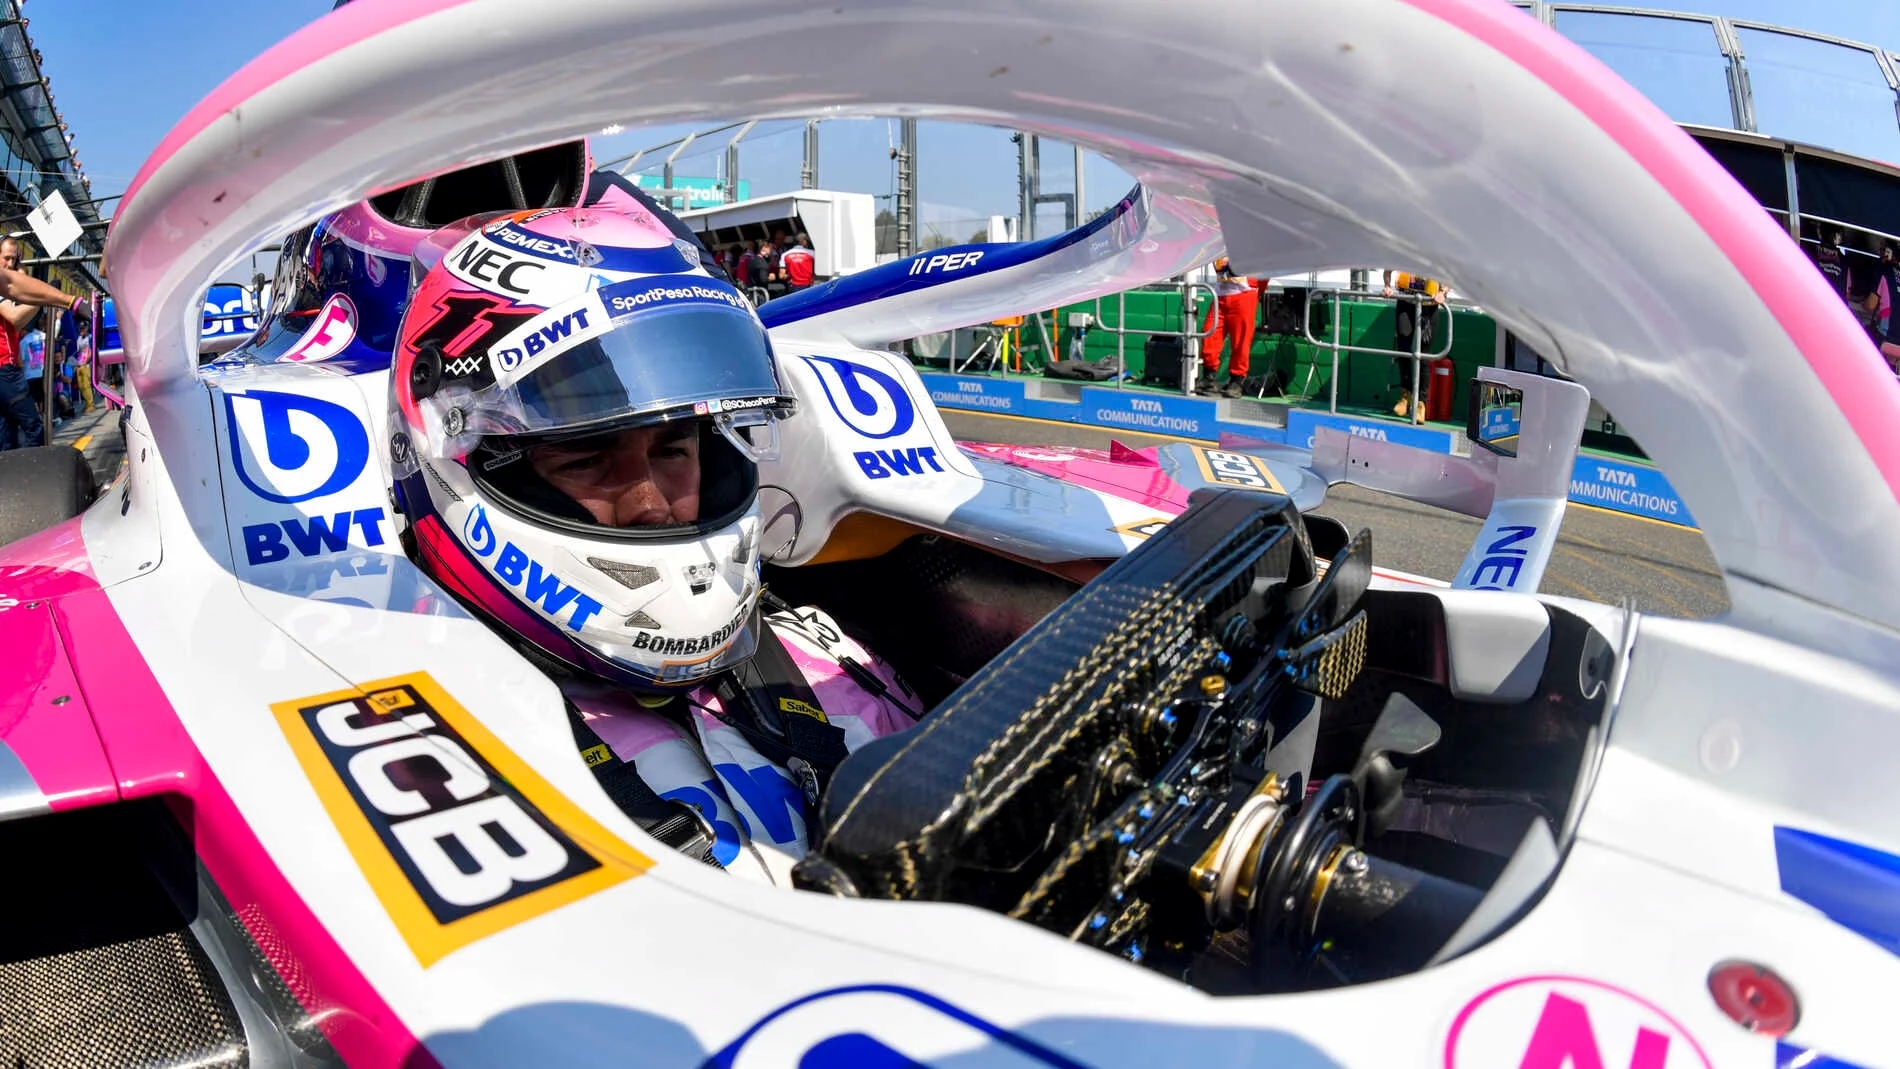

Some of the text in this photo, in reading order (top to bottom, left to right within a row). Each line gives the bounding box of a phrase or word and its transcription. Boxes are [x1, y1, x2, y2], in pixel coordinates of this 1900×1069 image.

[450, 240, 546, 295] NEC
[925, 251, 985, 274] PER
[612, 287, 691, 311] SportPesa
[690, 285, 737, 305] Racing
[523, 308, 590, 357] BWT
[932, 390, 1012, 409] COMMUNICATIONS
[957, 381, 983, 394] TATA
[722, 396, 776, 411] @SChecoPerez
[1130, 398, 1163, 413] TATA
[1097, 408, 1199, 433] COMMUNICATIONS
[1349, 425, 1388, 442] TATA
[853, 446, 946, 480] BWT
[1597, 466, 1637, 488] TATA
[242, 506, 386, 567] BWT
[1470, 525, 1537, 591] NE
[493, 541, 604, 633] BWT
[315, 701, 569, 907] JCB
